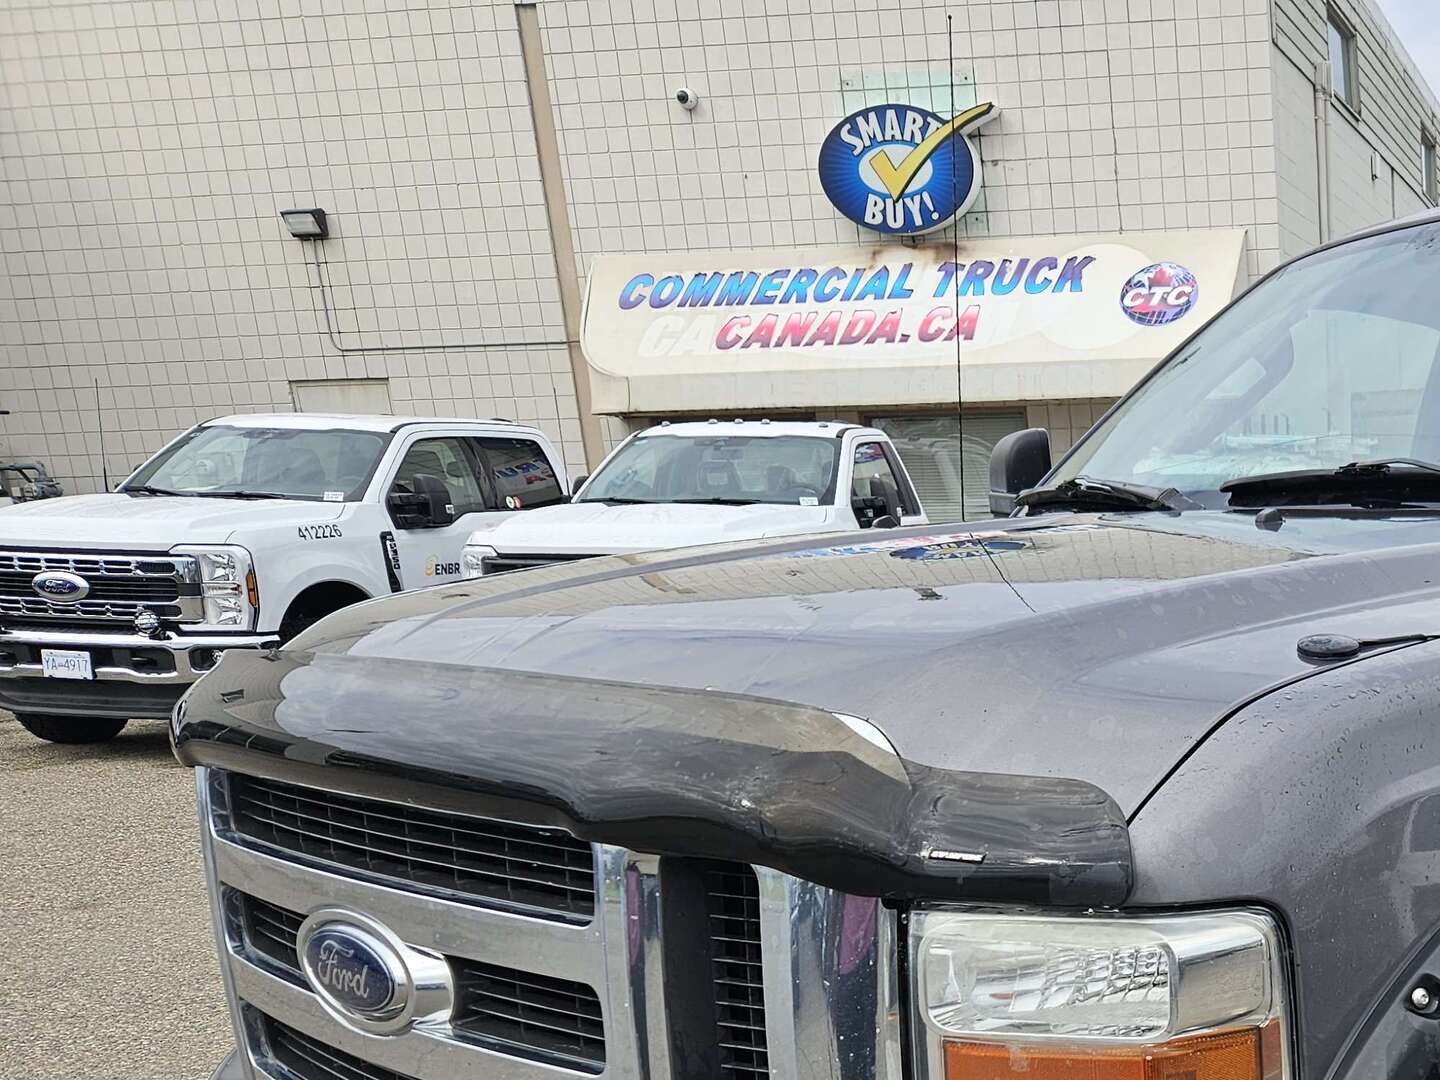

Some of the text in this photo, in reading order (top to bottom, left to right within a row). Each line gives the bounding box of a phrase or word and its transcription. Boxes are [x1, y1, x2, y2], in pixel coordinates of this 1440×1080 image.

[840, 108, 944, 156] SMART
[864, 191, 940, 229] BUY!
[618, 255, 1096, 310] COMMERCIAL TRUCK
[715, 304, 980, 350] CANADA.CA
[298, 524, 343, 540] 412226
[44, 579, 71, 593] Ford
[318, 939, 370, 999] Ford
